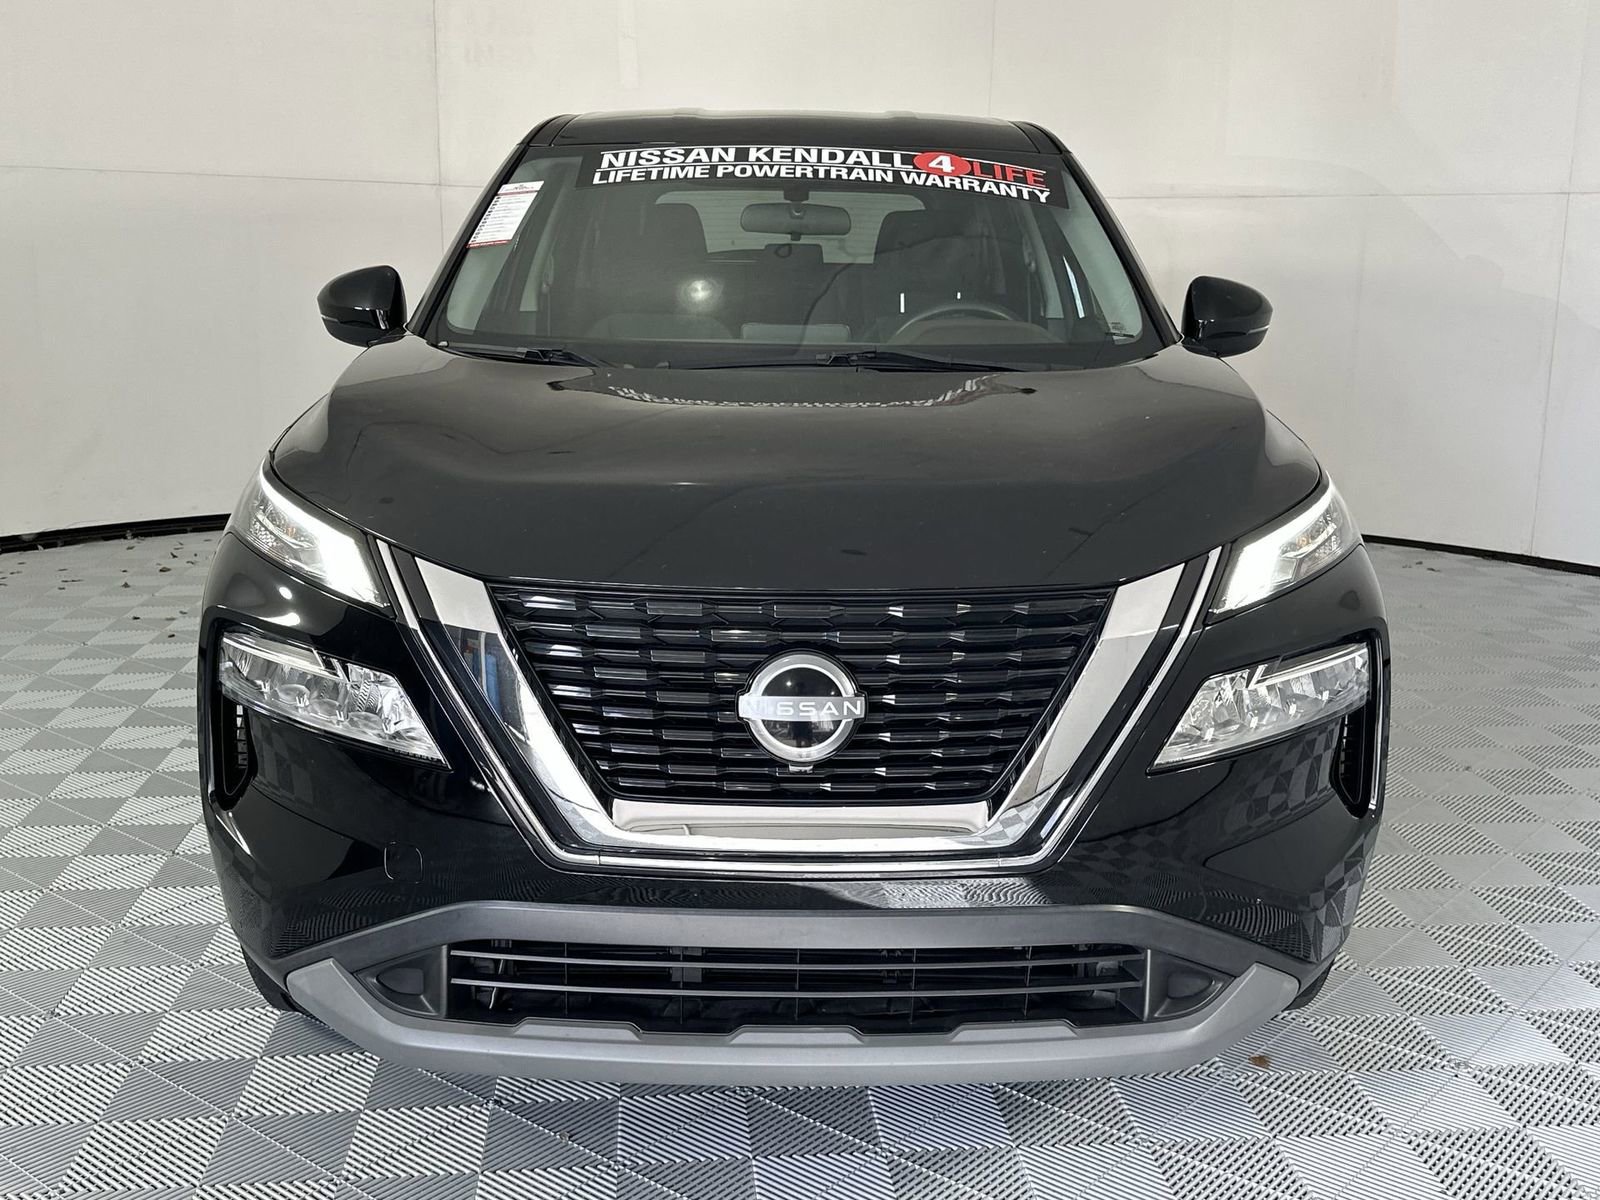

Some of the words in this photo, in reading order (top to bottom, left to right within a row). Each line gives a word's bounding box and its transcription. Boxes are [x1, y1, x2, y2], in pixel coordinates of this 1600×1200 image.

[592, 164, 710, 185] LIFETIME
[716, 164, 895, 184] POWERTRAIN
[900, 171, 1051, 203] WARRANTY
[600, 148, 736, 169] NISSAN
[748, 147, 914, 169] KENDALL
[928, 155, 955, 174] 4
[973, 161, 1046, 187] LIFE
[741, 700, 861, 716] NISSAN
